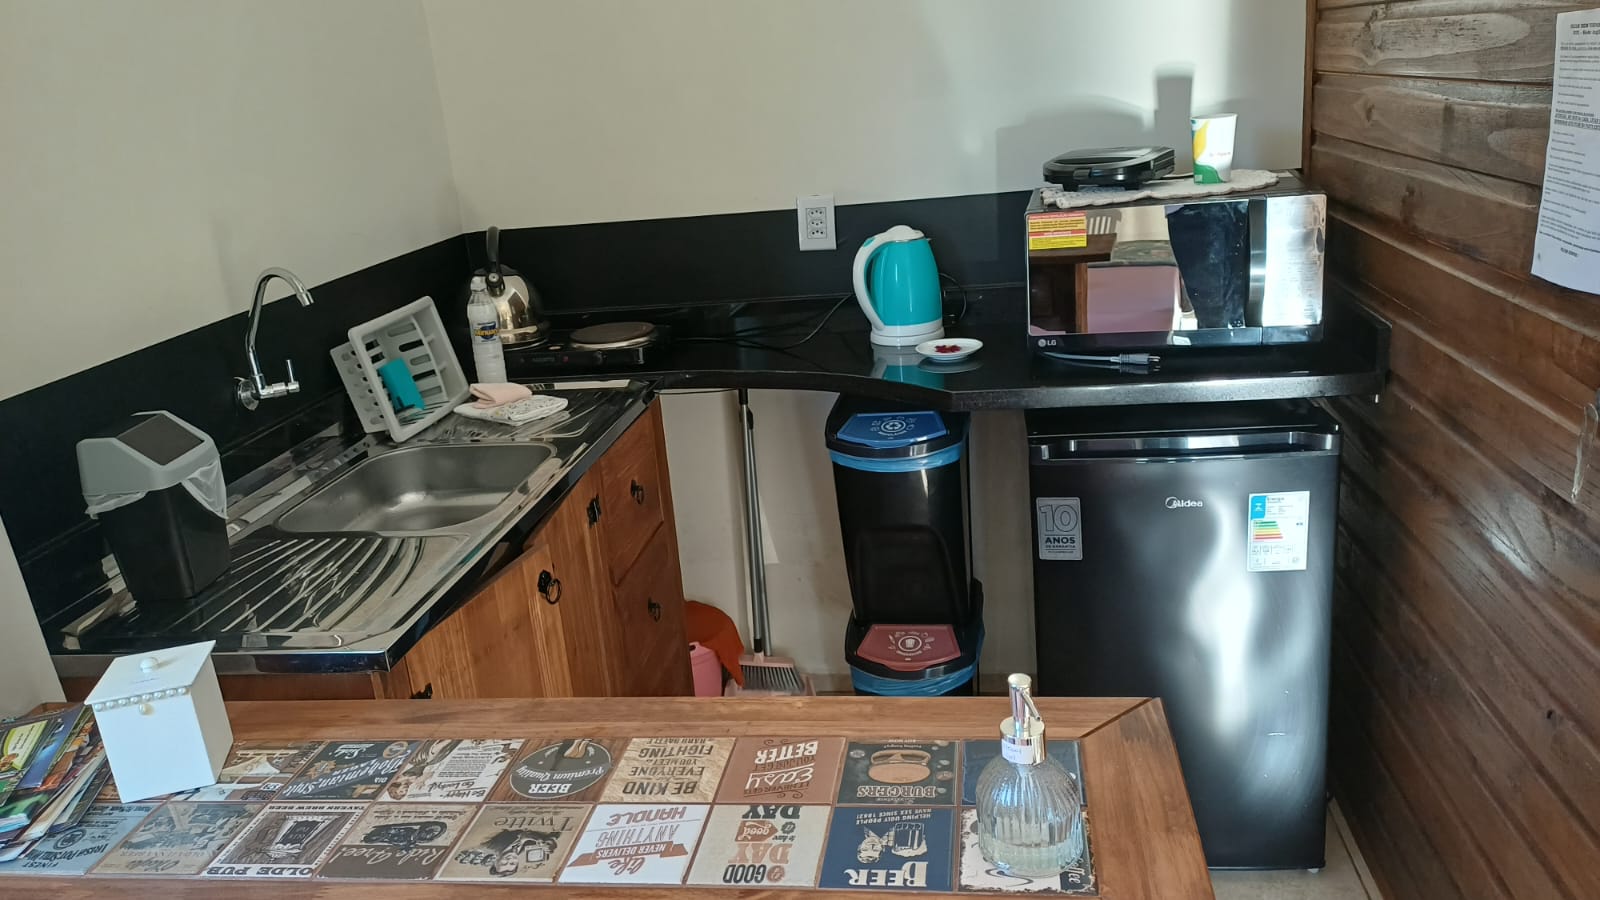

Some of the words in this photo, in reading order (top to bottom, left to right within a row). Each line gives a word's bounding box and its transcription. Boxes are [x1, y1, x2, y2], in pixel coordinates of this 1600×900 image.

[1165, 496, 1203, 509] Midea
[1039, 504, 1078, 532] 10
[1045, 536, 1076, 544] ANOS
[638, 745, 714, 759] FIGHTING
[754, 740, 819, 764] BETTER
[318, 755, 407, 788] Bohemian
[514, 765, 551, 782] Quality
[553, 766, 604, 781] Premium
[627, 766, 705, 777] EVERYONE
[745, 766, 814, 789] Easy
[282, 781, 319, 796] Style
[528, 783, 572, 794] BEER
[622, 782, 669, 796] KIND
[671, 781, 698, 795] BE
[856, 785, 936, 798] BURGERS
[606, 806, 687, 827] HANDLE
[741, 805, 802, 820] DAY
[878, 810, 898, 818] SINCE
[902, 813, 931, 821] HELPING
[493, 816, 575, 832] Twitte
[855, 817, 882, 825] PEOPLE
[595, 823, 680, 848] ANYTHING
[737, 822, 771, 840] good
[327, 847, 393, 865] Free!
[396, 847, 446, 866] Ride
[595, 846, 637, 859] DELIVERS
[637, 843, 666, 855] NEVER
[727, 843, 793, 864] DAY
[205, 866, 251, 876] PUB
[256, 866, 313, 876] OLDE
[607, 857, 645, 876] life
[722, 864, 767, 884] GOOD
[843, 861, 929, 887] BEER
